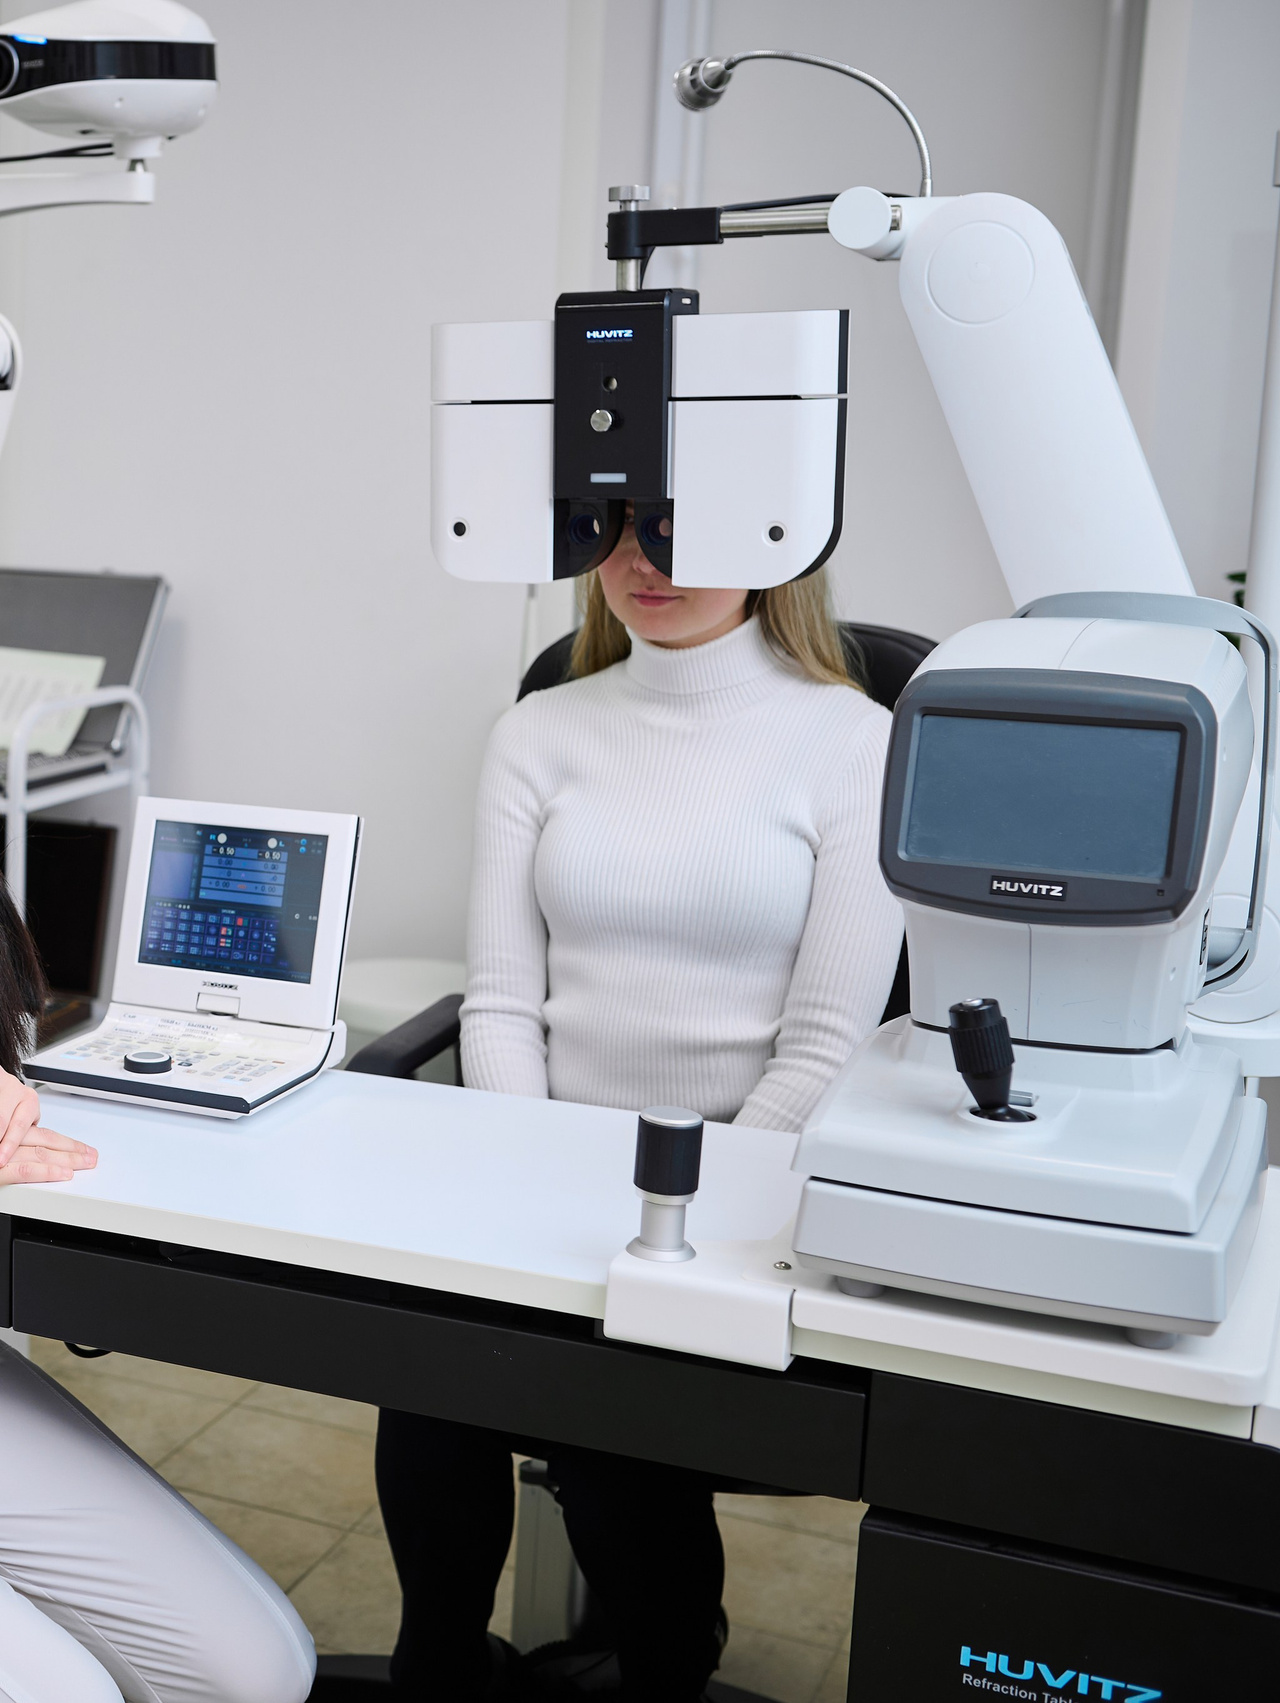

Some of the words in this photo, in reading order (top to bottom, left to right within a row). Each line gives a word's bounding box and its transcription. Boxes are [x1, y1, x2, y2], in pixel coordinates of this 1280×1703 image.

[586, 329, 633, 339] HUVITZ
[992, 880, 1063, 897] HUVITZ
[960, 1645, 1162, 1703] HUVITZ
[962, 1673, 1037, 1701] Refraction
